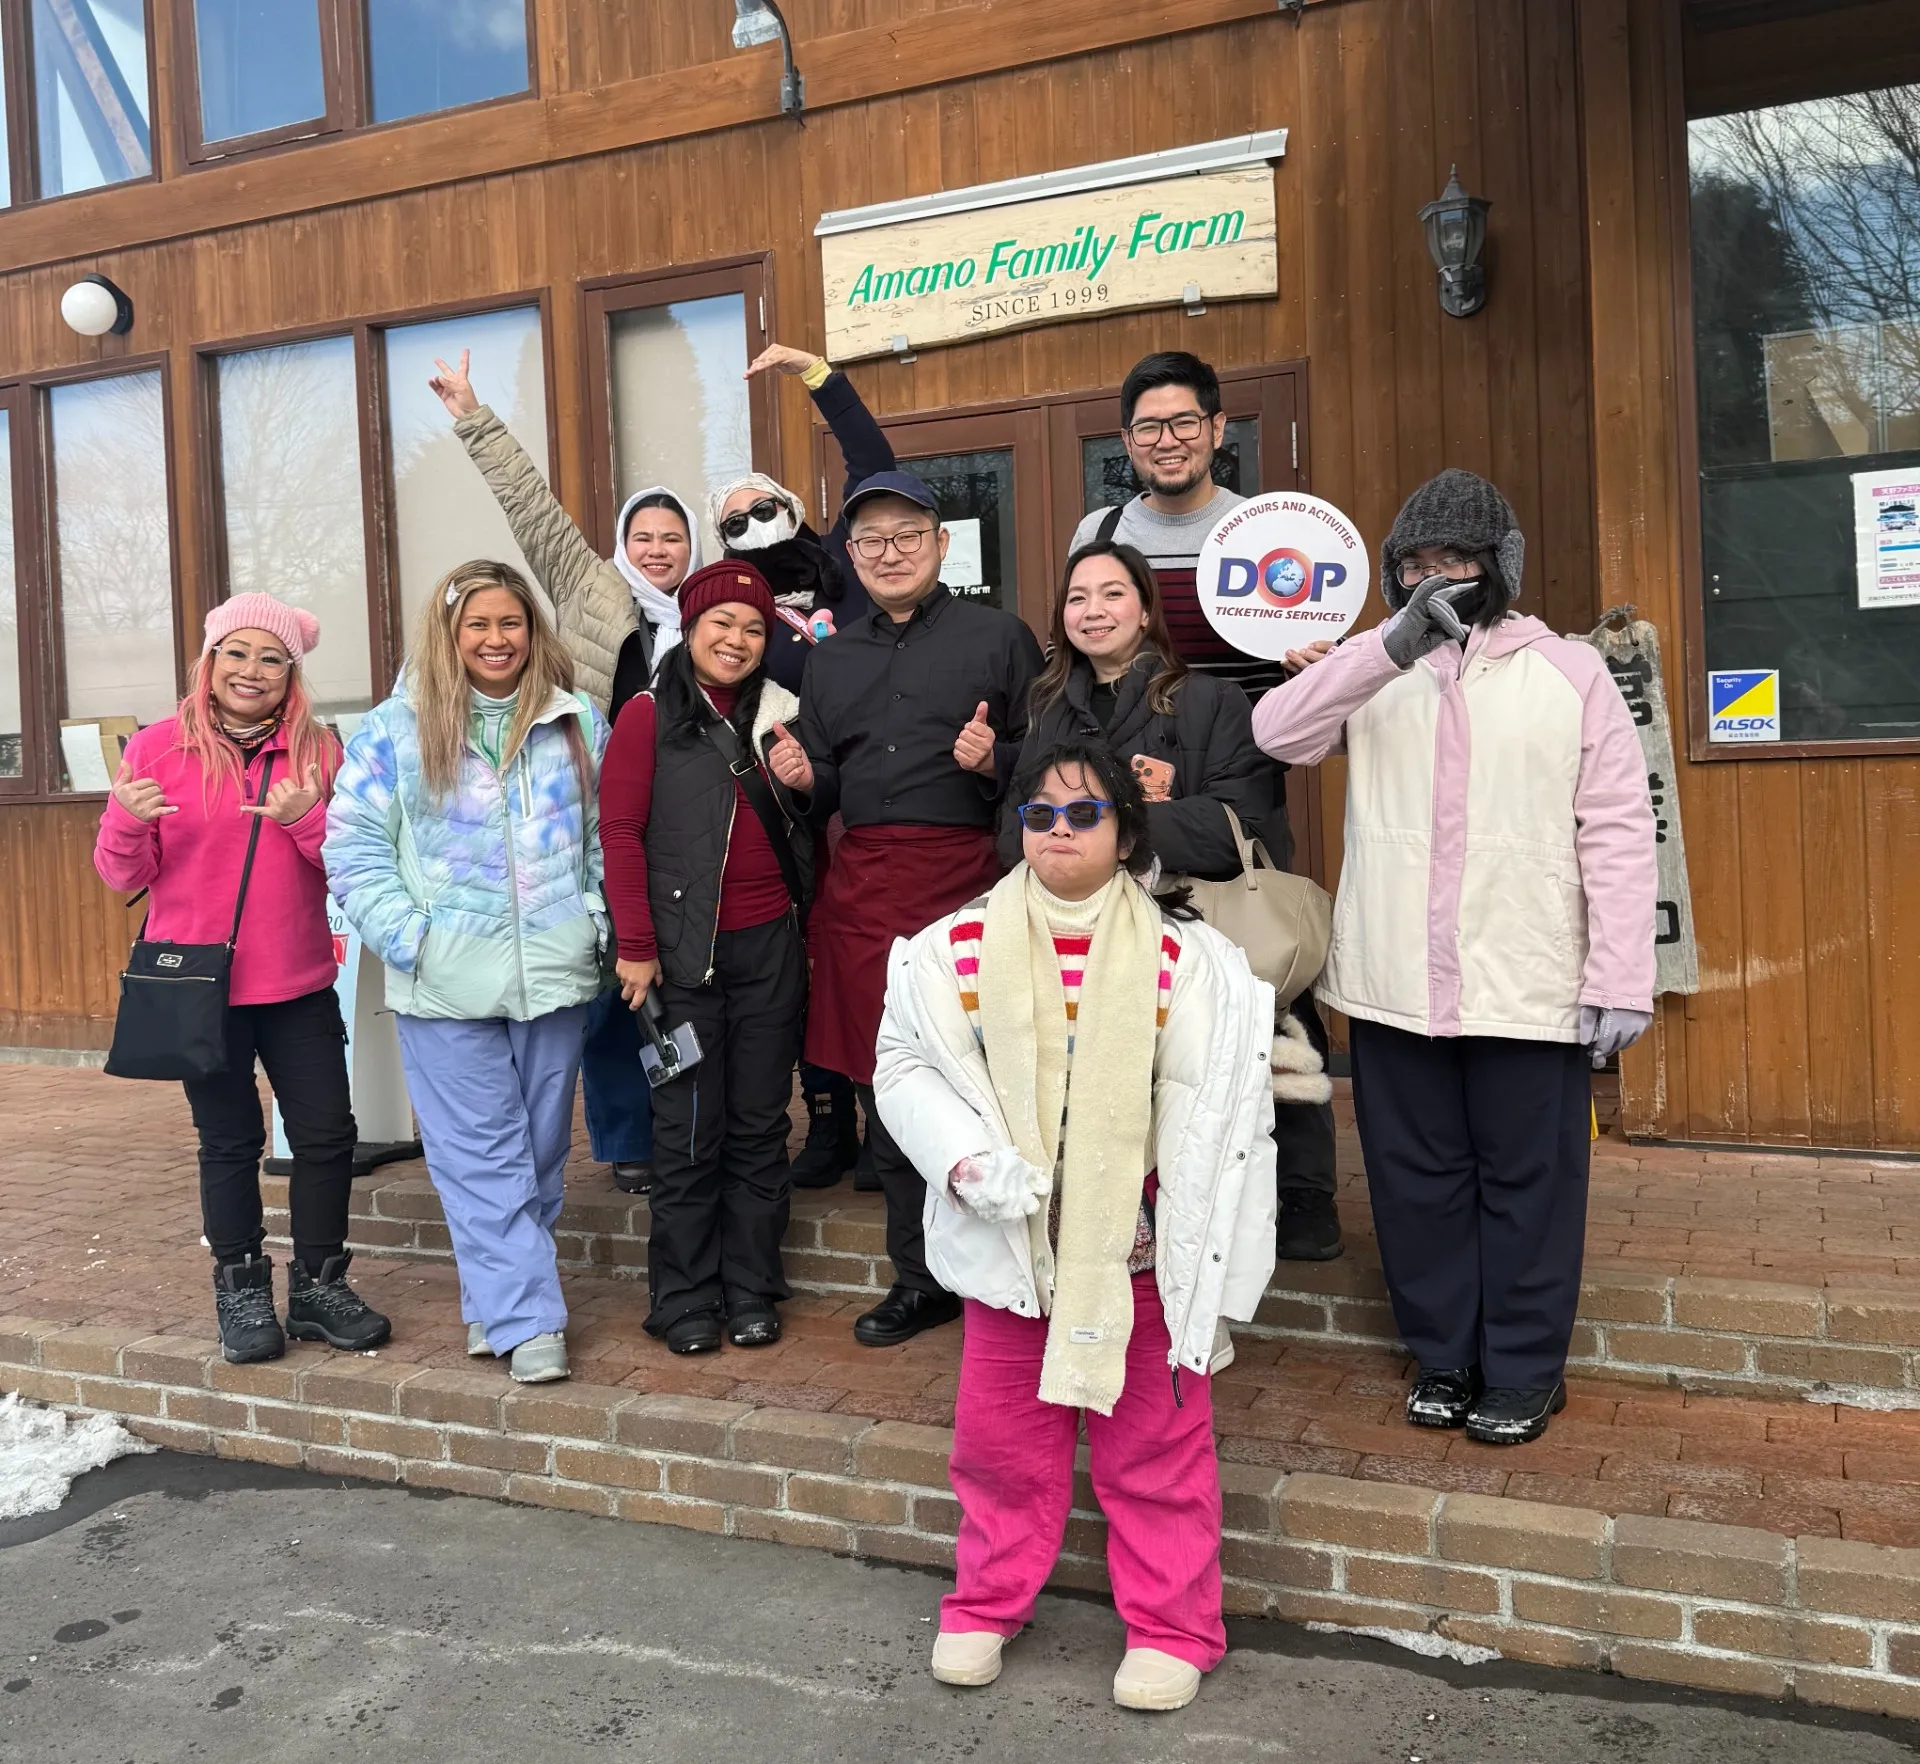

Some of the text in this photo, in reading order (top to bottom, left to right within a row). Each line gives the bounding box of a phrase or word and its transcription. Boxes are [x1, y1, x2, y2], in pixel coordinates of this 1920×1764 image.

[847, 209, 1245, 306] Amano Family Farm
[971, 284, 1109, 323] SINCE 1999
[1214, 501, 1357, 550] JAPAN TOURS AND ACTIVITIES
[964, 585, 991, 595] Farm
[1216, 547, 1347, 608] DOP
[1215, 606, 1346, 622] TICKETING SERVICES
[1714, 718, 1775, 730] ALSOK
